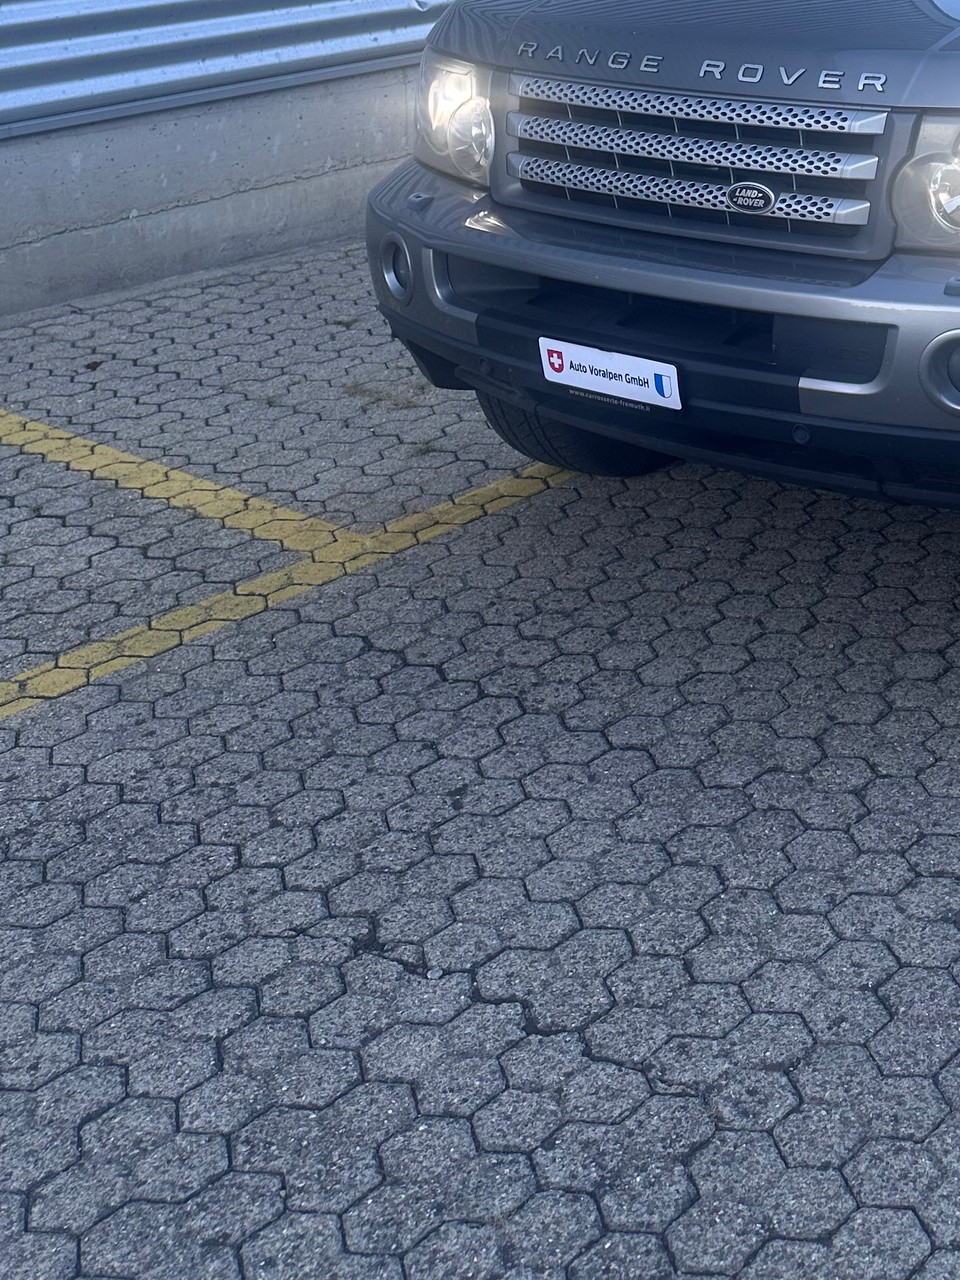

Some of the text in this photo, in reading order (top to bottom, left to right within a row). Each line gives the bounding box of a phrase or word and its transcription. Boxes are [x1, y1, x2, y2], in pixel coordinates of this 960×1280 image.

[517, 42, 888, 92] RANGE ROVER
[735, 188, 758, 198] LAND
[737, 197, 765, 207] ROVER
[569, 360, 650, 388] Auto Voralpen GmbH
